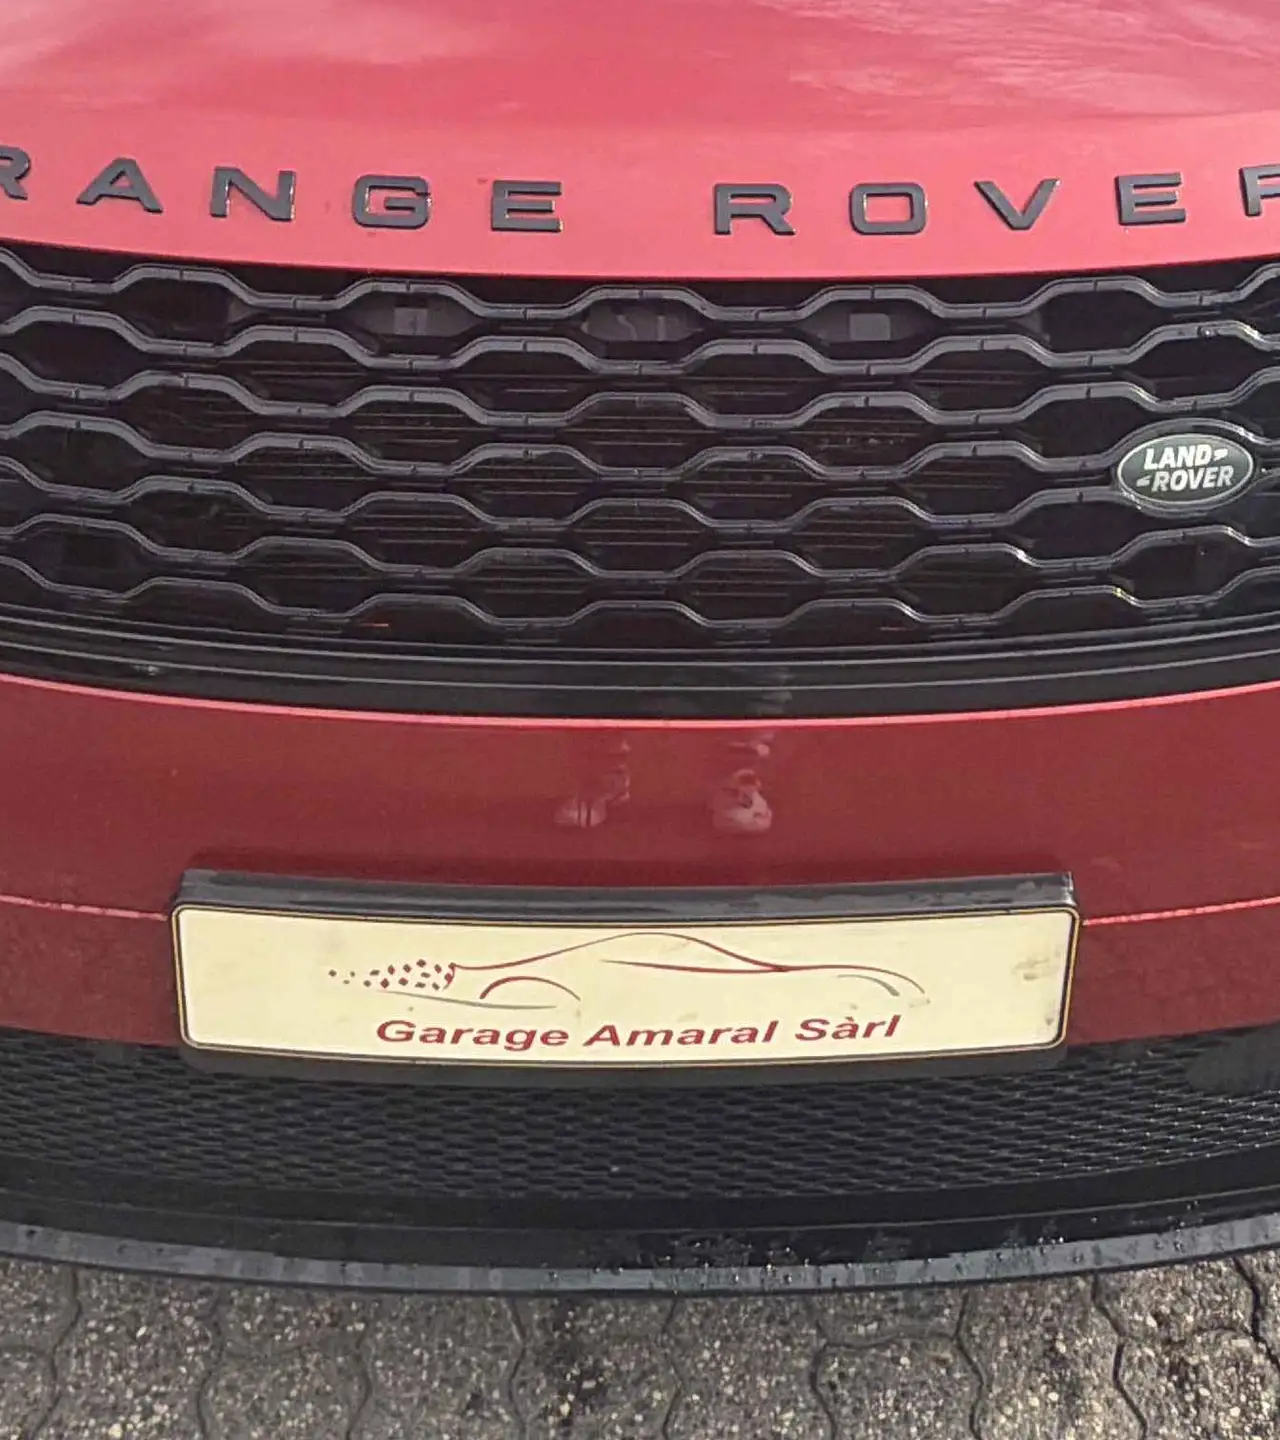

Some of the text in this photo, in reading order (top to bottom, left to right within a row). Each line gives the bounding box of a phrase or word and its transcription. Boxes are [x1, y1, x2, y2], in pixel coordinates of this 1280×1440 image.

[1144, 444, 1213, 471] LAND
[1151, 465, 1235, 492] ROVER
[376, 1014, 902, 1052] Garage Amaral Sàrl
